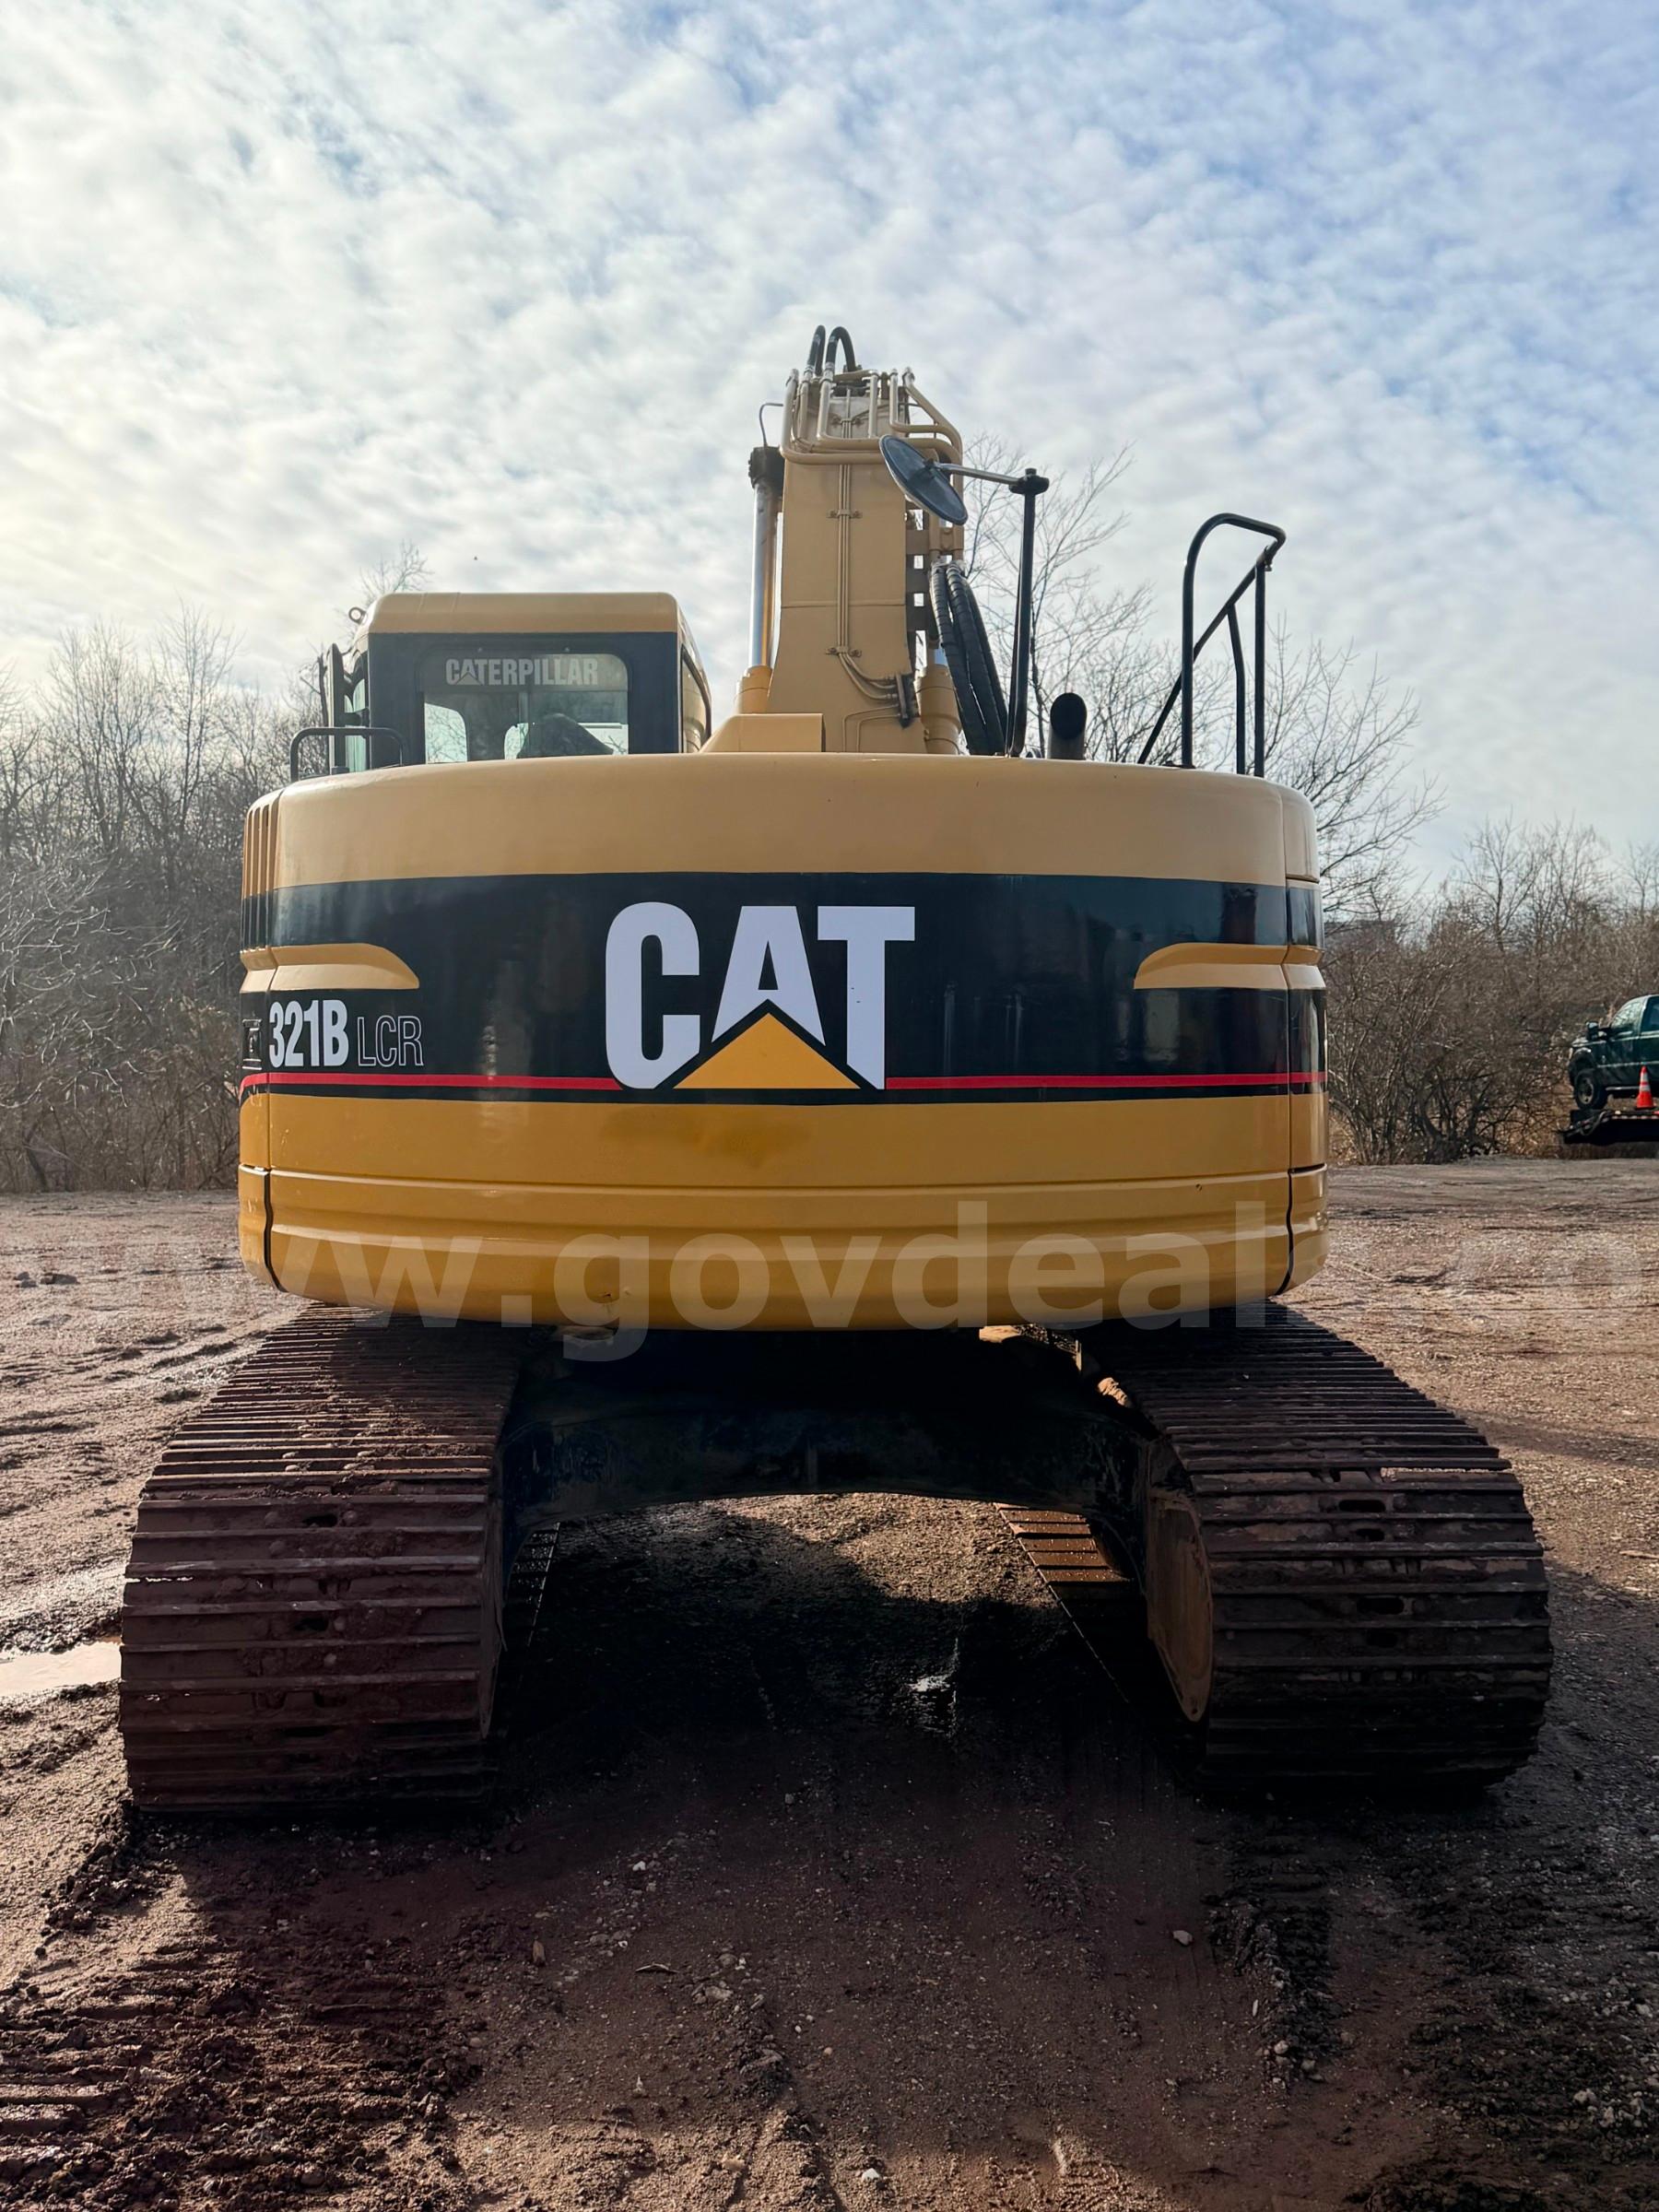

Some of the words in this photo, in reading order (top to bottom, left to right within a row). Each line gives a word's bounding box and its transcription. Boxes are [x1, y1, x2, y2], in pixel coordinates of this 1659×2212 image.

[445, 658, 599, 686] CATERPILLAR
[605, 901, 916, 1090] CAT
[268, 999, 349, 1068] 321B
[357, 1015, 425, 1067] LCR
